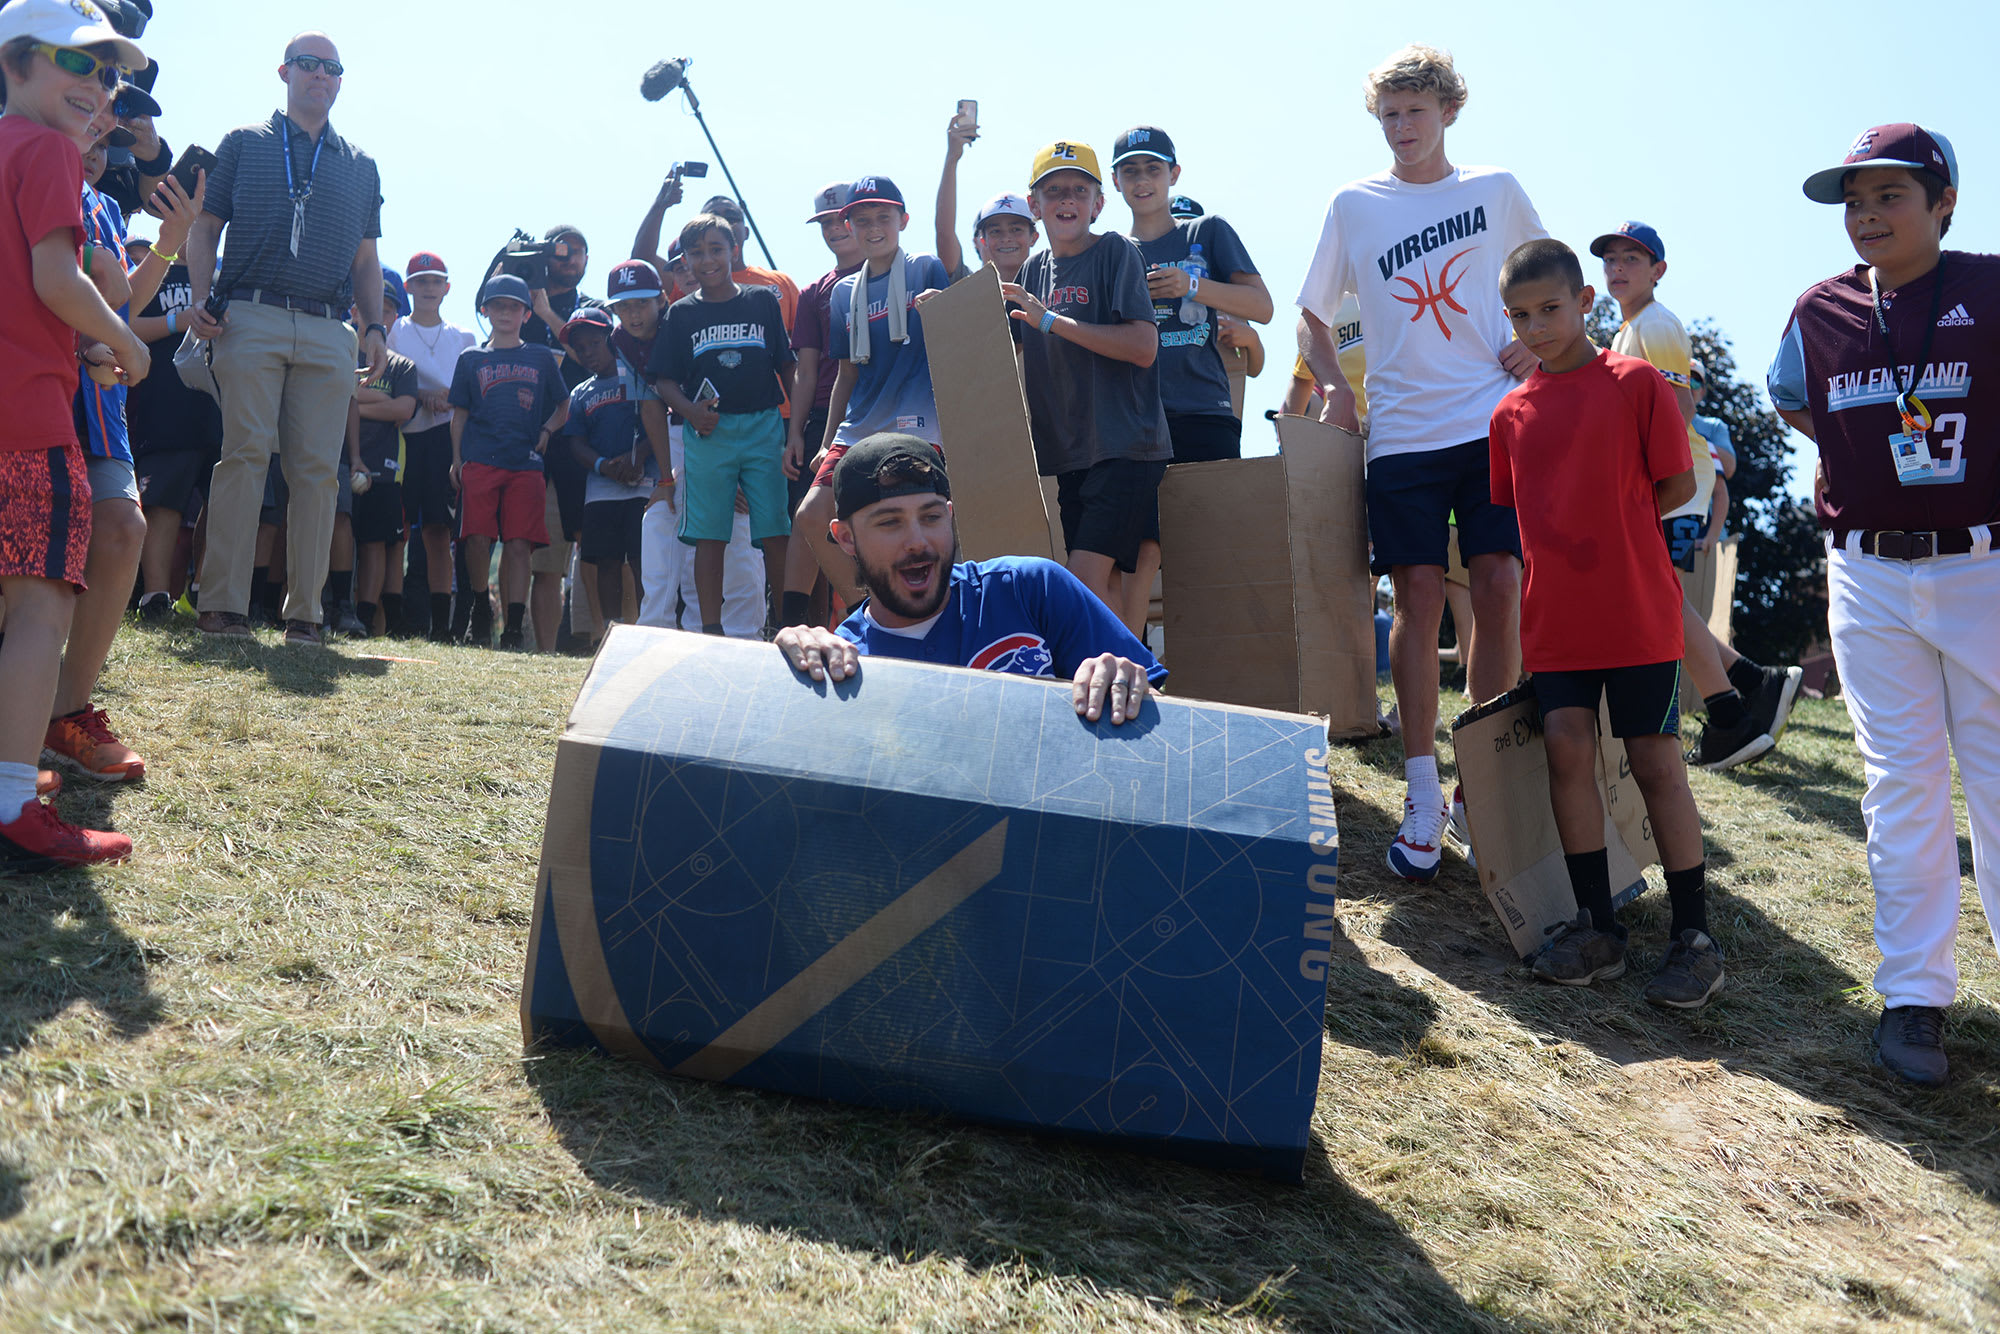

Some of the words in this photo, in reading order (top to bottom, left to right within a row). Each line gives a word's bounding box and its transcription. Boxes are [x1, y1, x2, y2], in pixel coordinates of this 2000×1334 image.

[1128, 130, 1150, 147] NW
[1053, 142, 1077, 160] SE
[856, 176, 878, 193] MA
[1377, 205, 1488, 281] VIRGINIA
[618, 267, 636, 285] NE
[1937, 317, 1975, 327] adidas
[691, 324, 765, 350] CARIBBEAN
[1161, 323, 1211, 348] SERIES
[1828, 371, 1862, 400] NEW
[1868, 362, 1968, 392] ENGLAND
[1299, 748, 1339, 983] SAMSUNG
